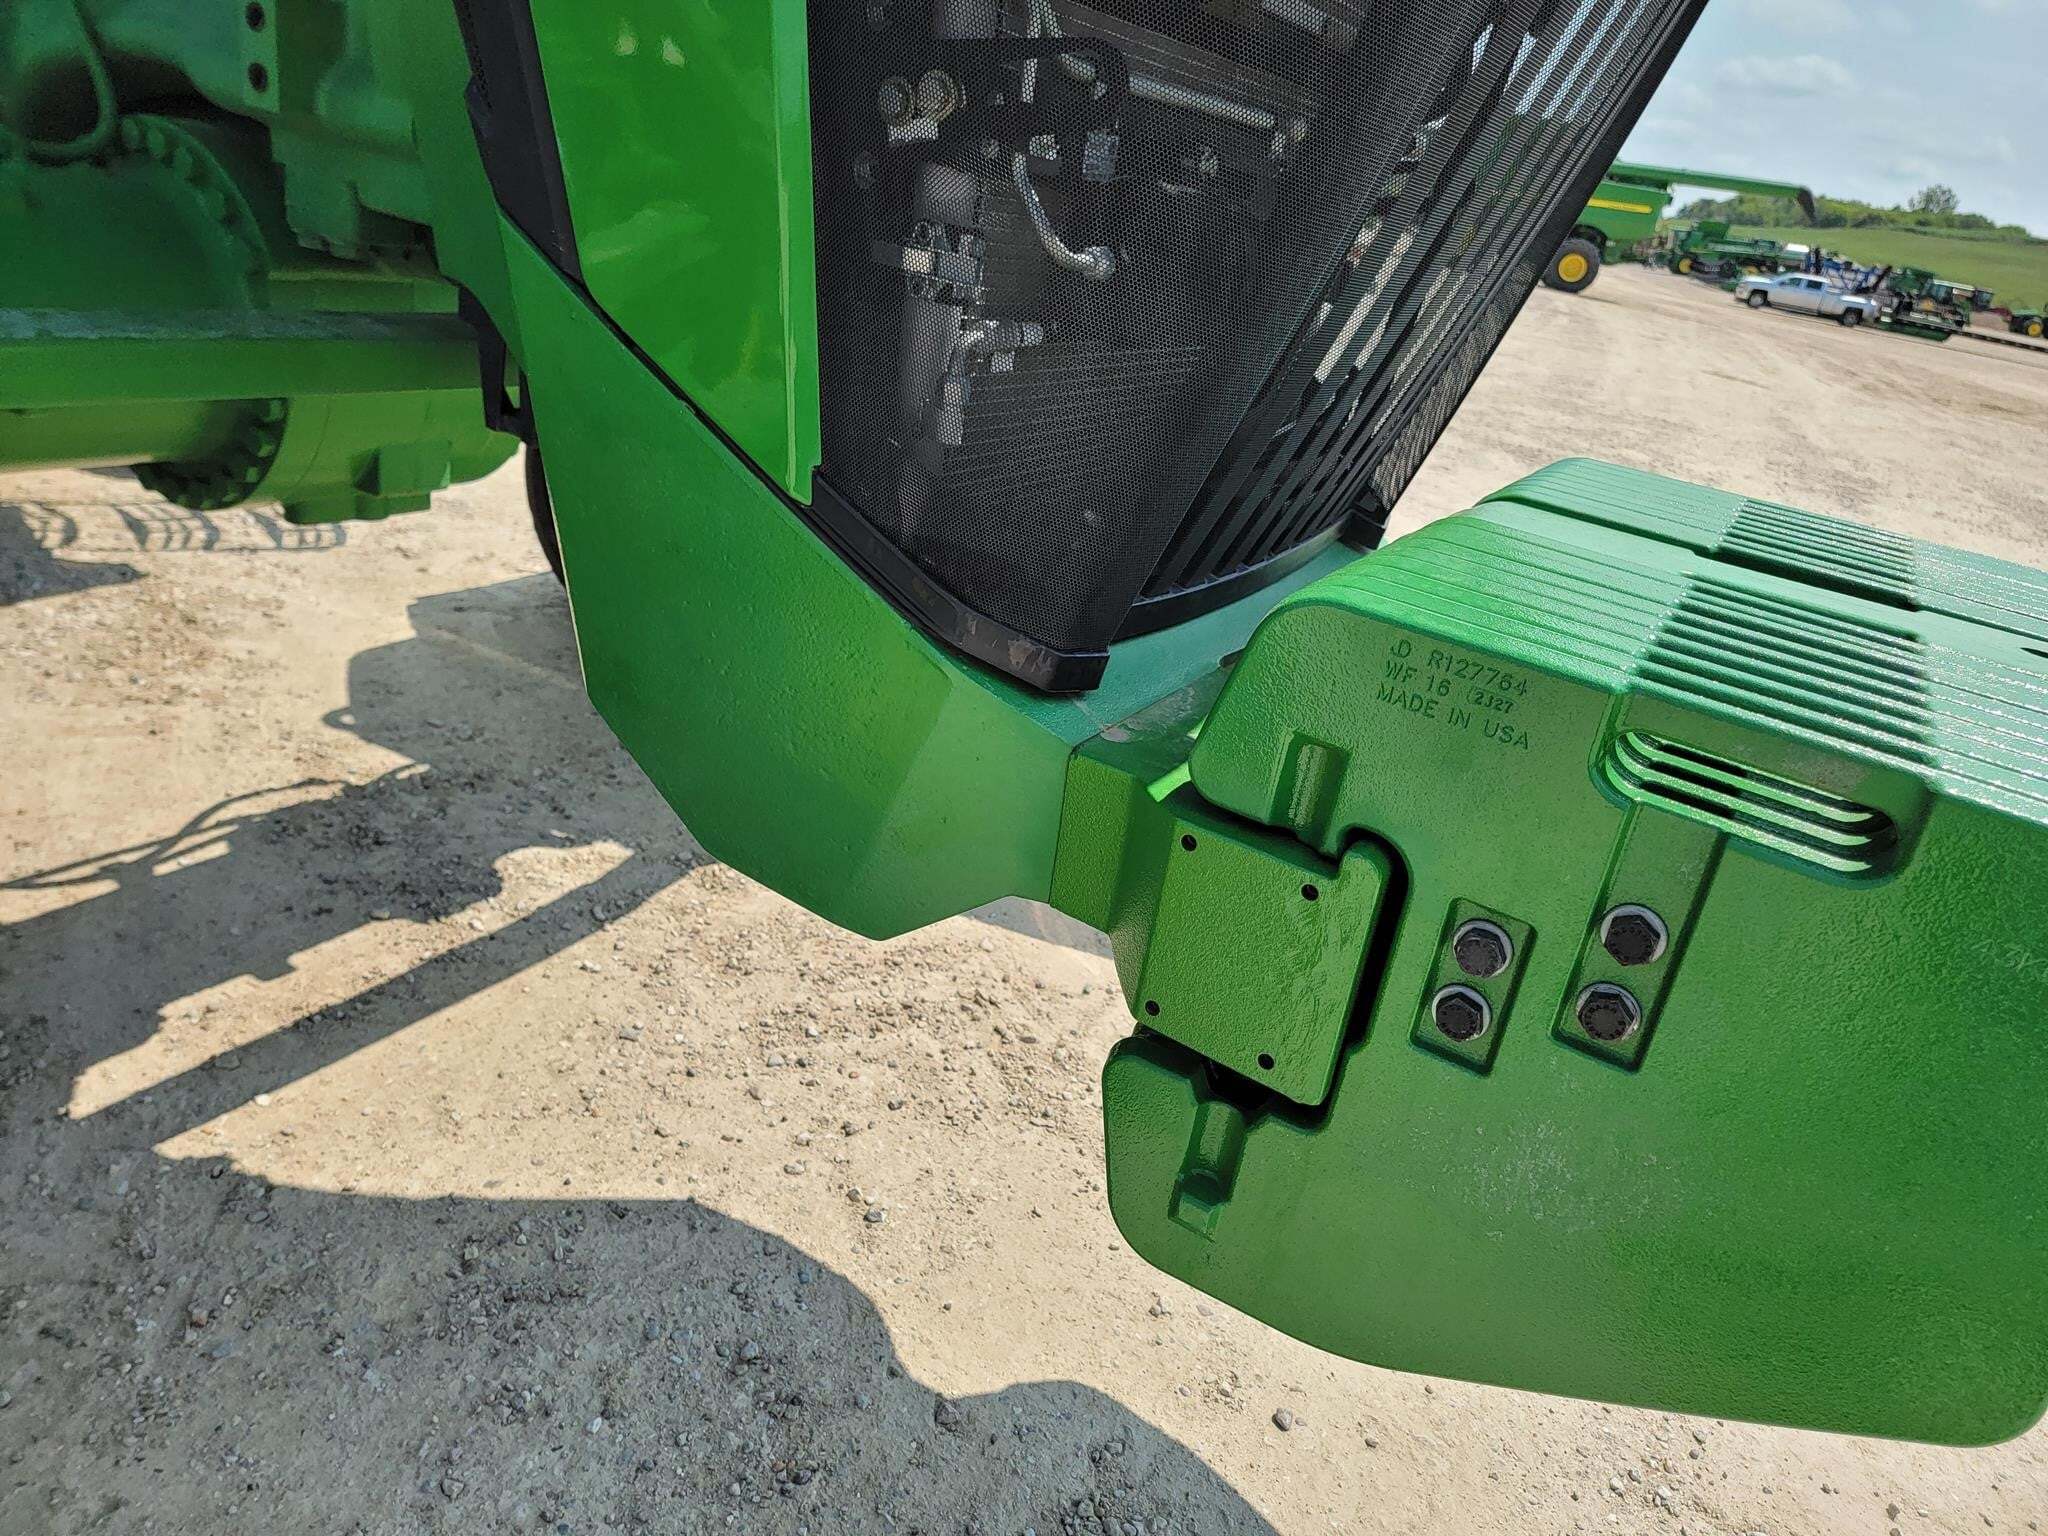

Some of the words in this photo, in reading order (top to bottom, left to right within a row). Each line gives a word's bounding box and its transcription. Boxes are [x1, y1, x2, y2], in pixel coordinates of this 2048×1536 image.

[1385, 660, 1417, 682] WF
[1427, 675, 1451, 697] 16
[1428, 650, 1527, 695] R127764
[1376, 680, 1439, 718] MADE
[1447, 707, 1472, 729] IN
[1483, 719, 1529, 750] USA
